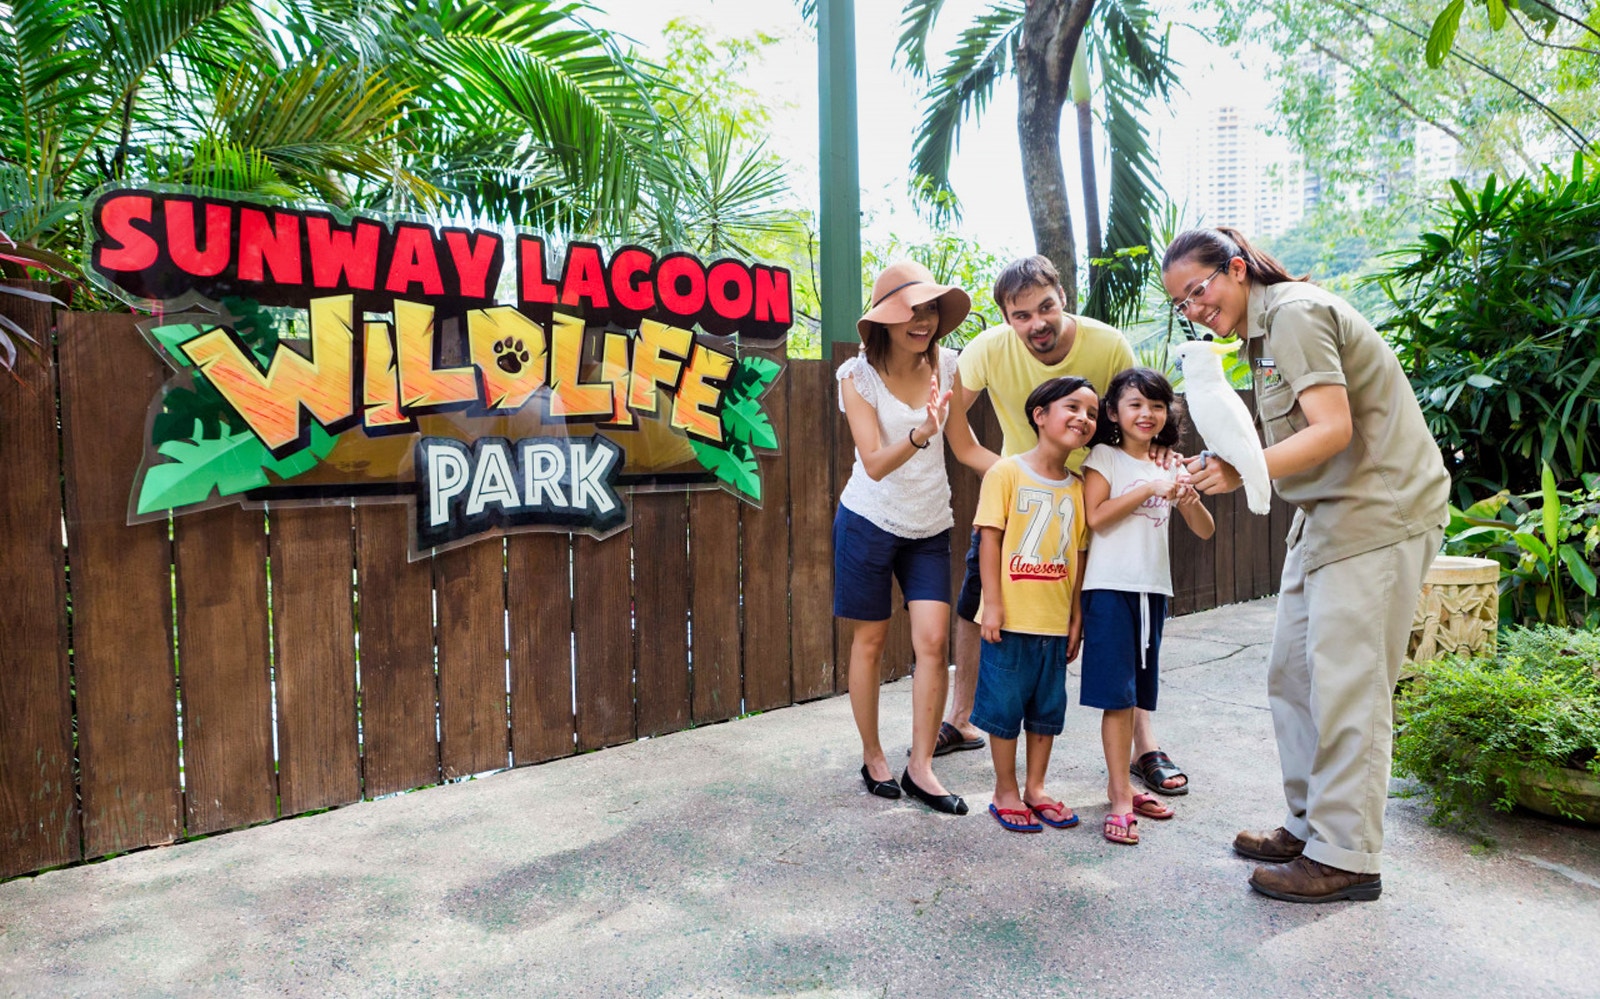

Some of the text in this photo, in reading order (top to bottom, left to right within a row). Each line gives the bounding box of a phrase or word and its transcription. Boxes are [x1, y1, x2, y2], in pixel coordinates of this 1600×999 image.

[99, 194, 791, 324] SUNWAY LAGOON
[180, 293, 739, 450] WILDLIFE
[427, 443, 615, 527] PARK
[1011, 487, 1074, 566] 71
